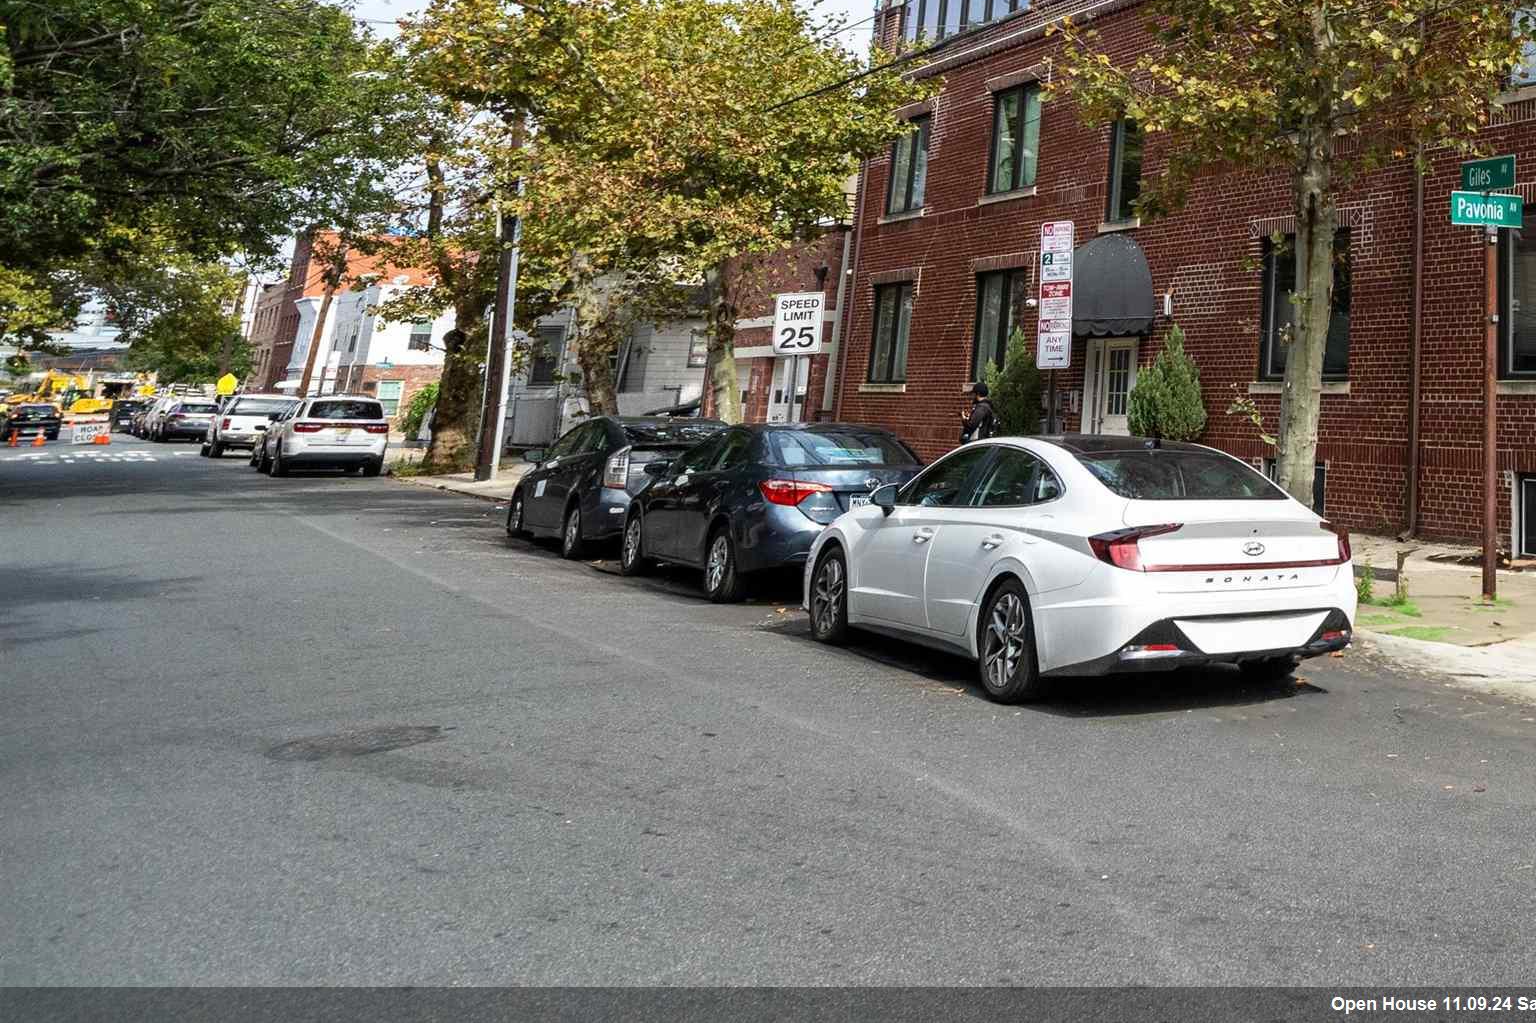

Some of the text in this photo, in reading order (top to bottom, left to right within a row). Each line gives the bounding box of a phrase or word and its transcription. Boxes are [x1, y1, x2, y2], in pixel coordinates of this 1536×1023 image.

[1469, 168, 1491, 186] Giles
[1457, 197, 1503, 220] Pavonia
[1044, 254, 1051, 265] 2
[781, 299, 820, 310] SPEED
[783, 311, 814, 321] LIMIT
[1041, 321, 1050, 331] NO
[780, 327, 814, 349] 25
[1045, 345, 1064, 353] TIME
[1205, 574, 1299, 583] SONATA
